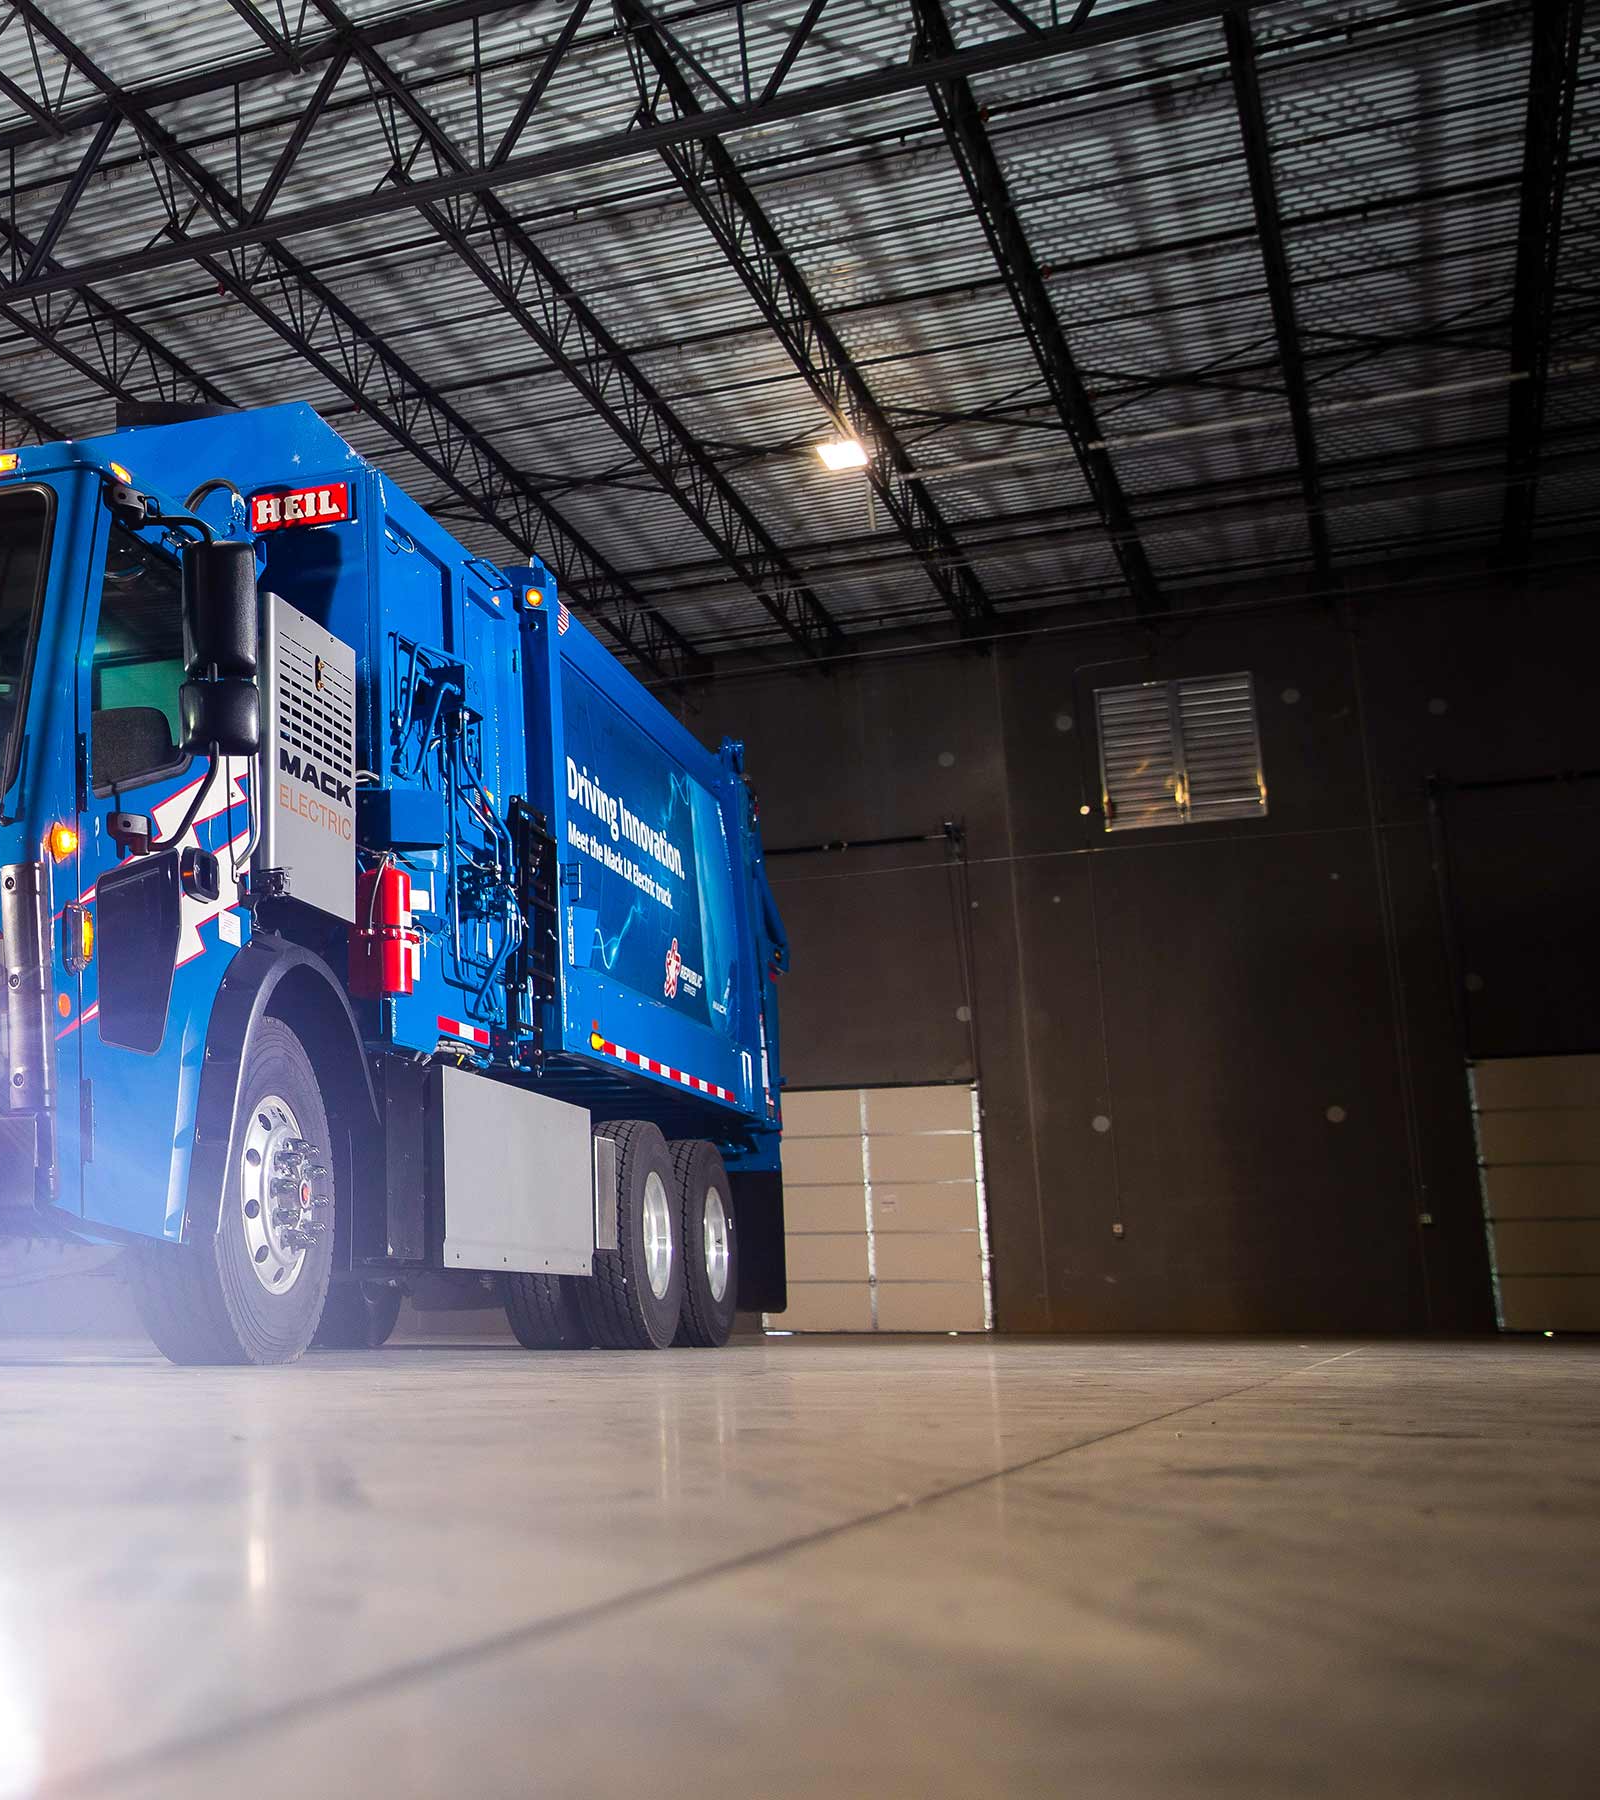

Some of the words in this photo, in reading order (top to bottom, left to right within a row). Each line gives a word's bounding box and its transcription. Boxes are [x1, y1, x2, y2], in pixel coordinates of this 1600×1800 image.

[257, 490, 340, 525] HEIL
[279, 747, 352, 808] MACK
[279, 783, 352, 841] ELECTRIC
[566, 756, 620, 842] Driving
[619, 797, 686, 881] Innovation.
[568, 820, 590, 855] Meet
[590, 834, 604, 863] the
[604, 844, 624, 877] Mack
[623, 857, 633, 883] LR
[633, 864, 656, 898] Electric
[655, 884, 674, 910] truck.
